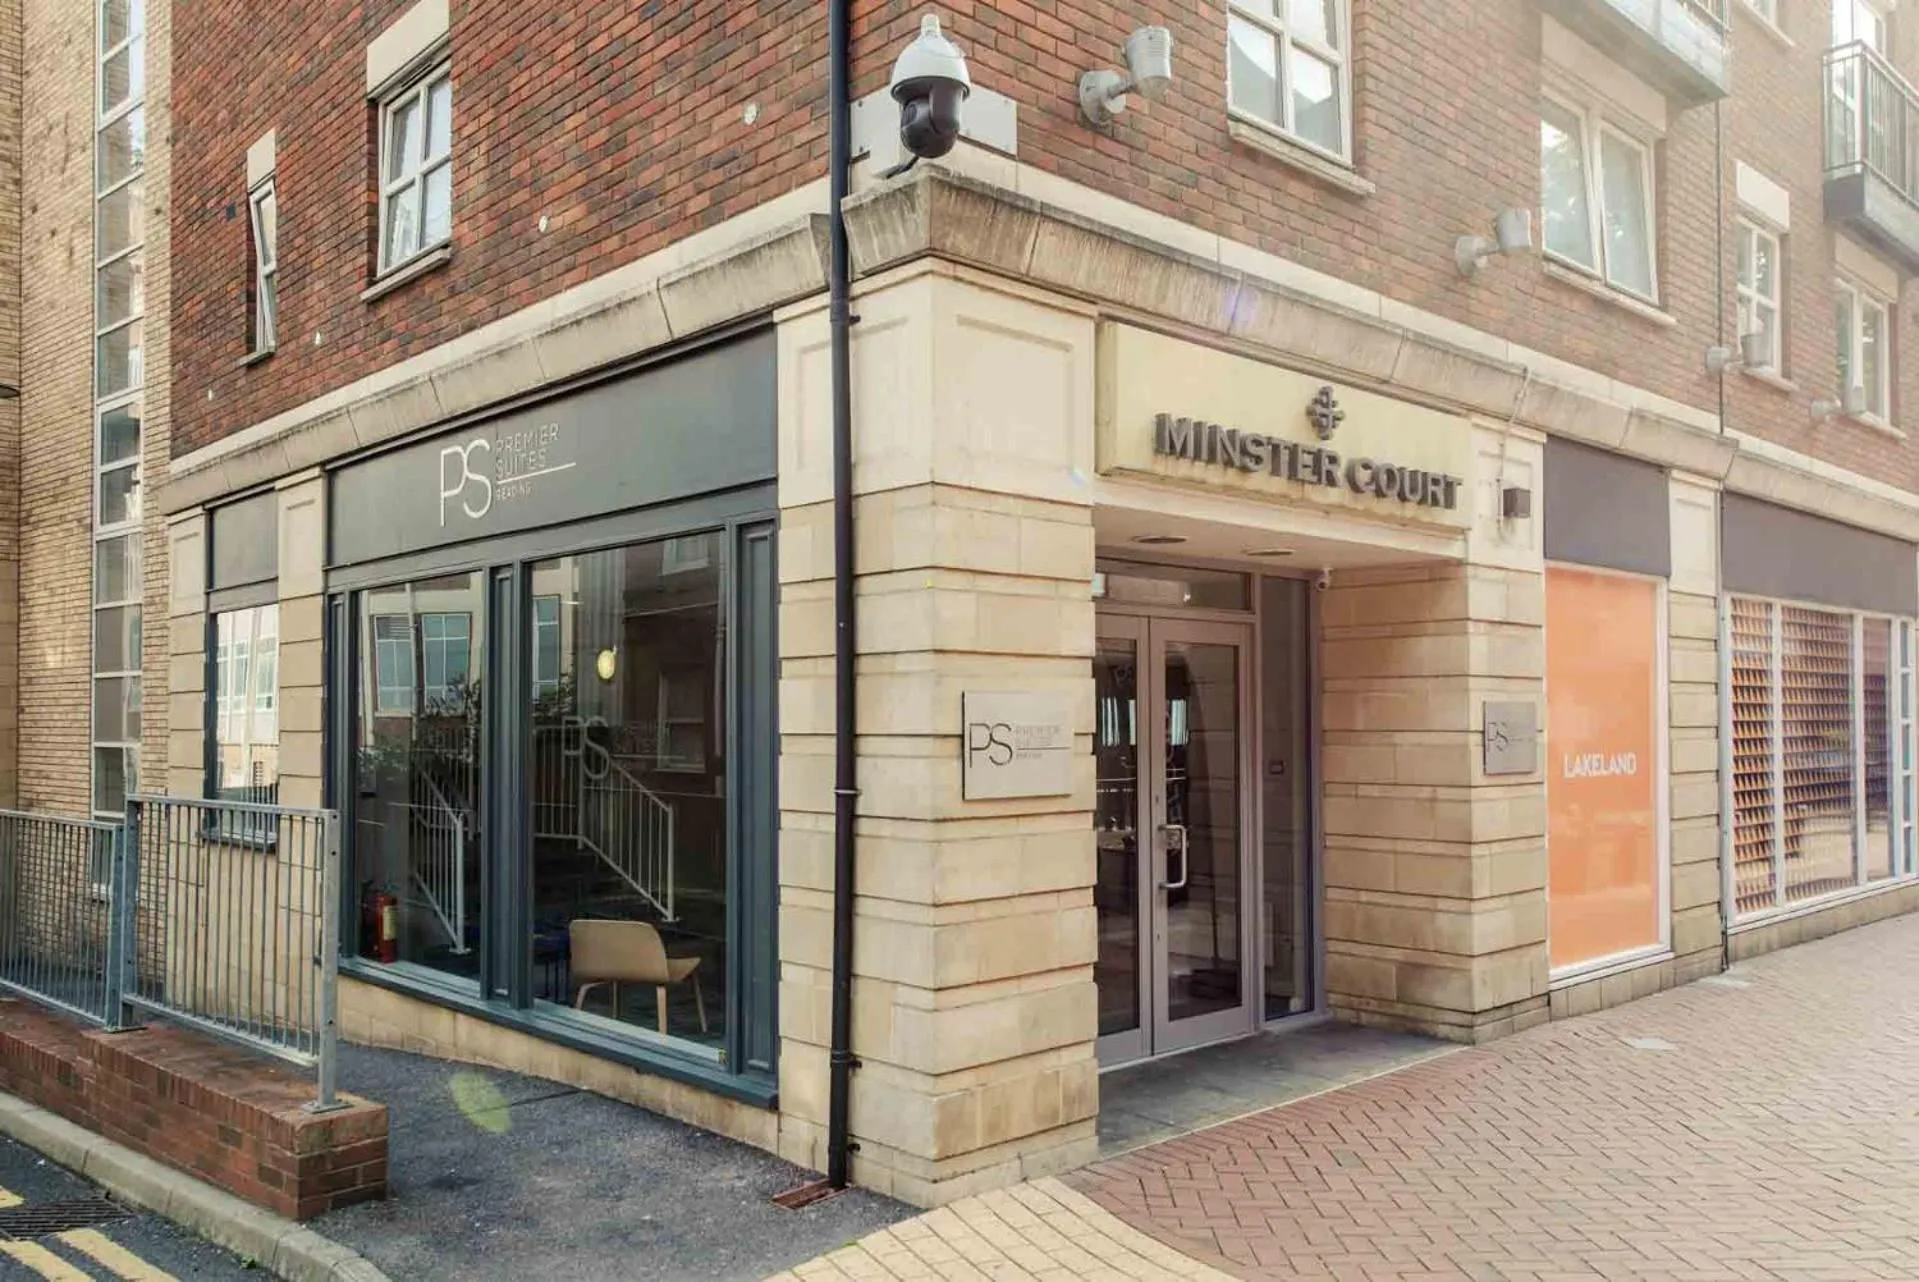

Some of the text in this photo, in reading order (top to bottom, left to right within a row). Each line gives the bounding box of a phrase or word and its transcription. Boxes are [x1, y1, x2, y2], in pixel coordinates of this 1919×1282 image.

[496, 423, 559, 453] PREMIER
[496, 448, 547, 479] SUITES
[1154, 412, 1464, 510] MINSTER COURT
[440, 439, 492, 527] PS
[968, 722, 1013, 768] PS
[1564, 752, 1637, 779] LAKELAND
